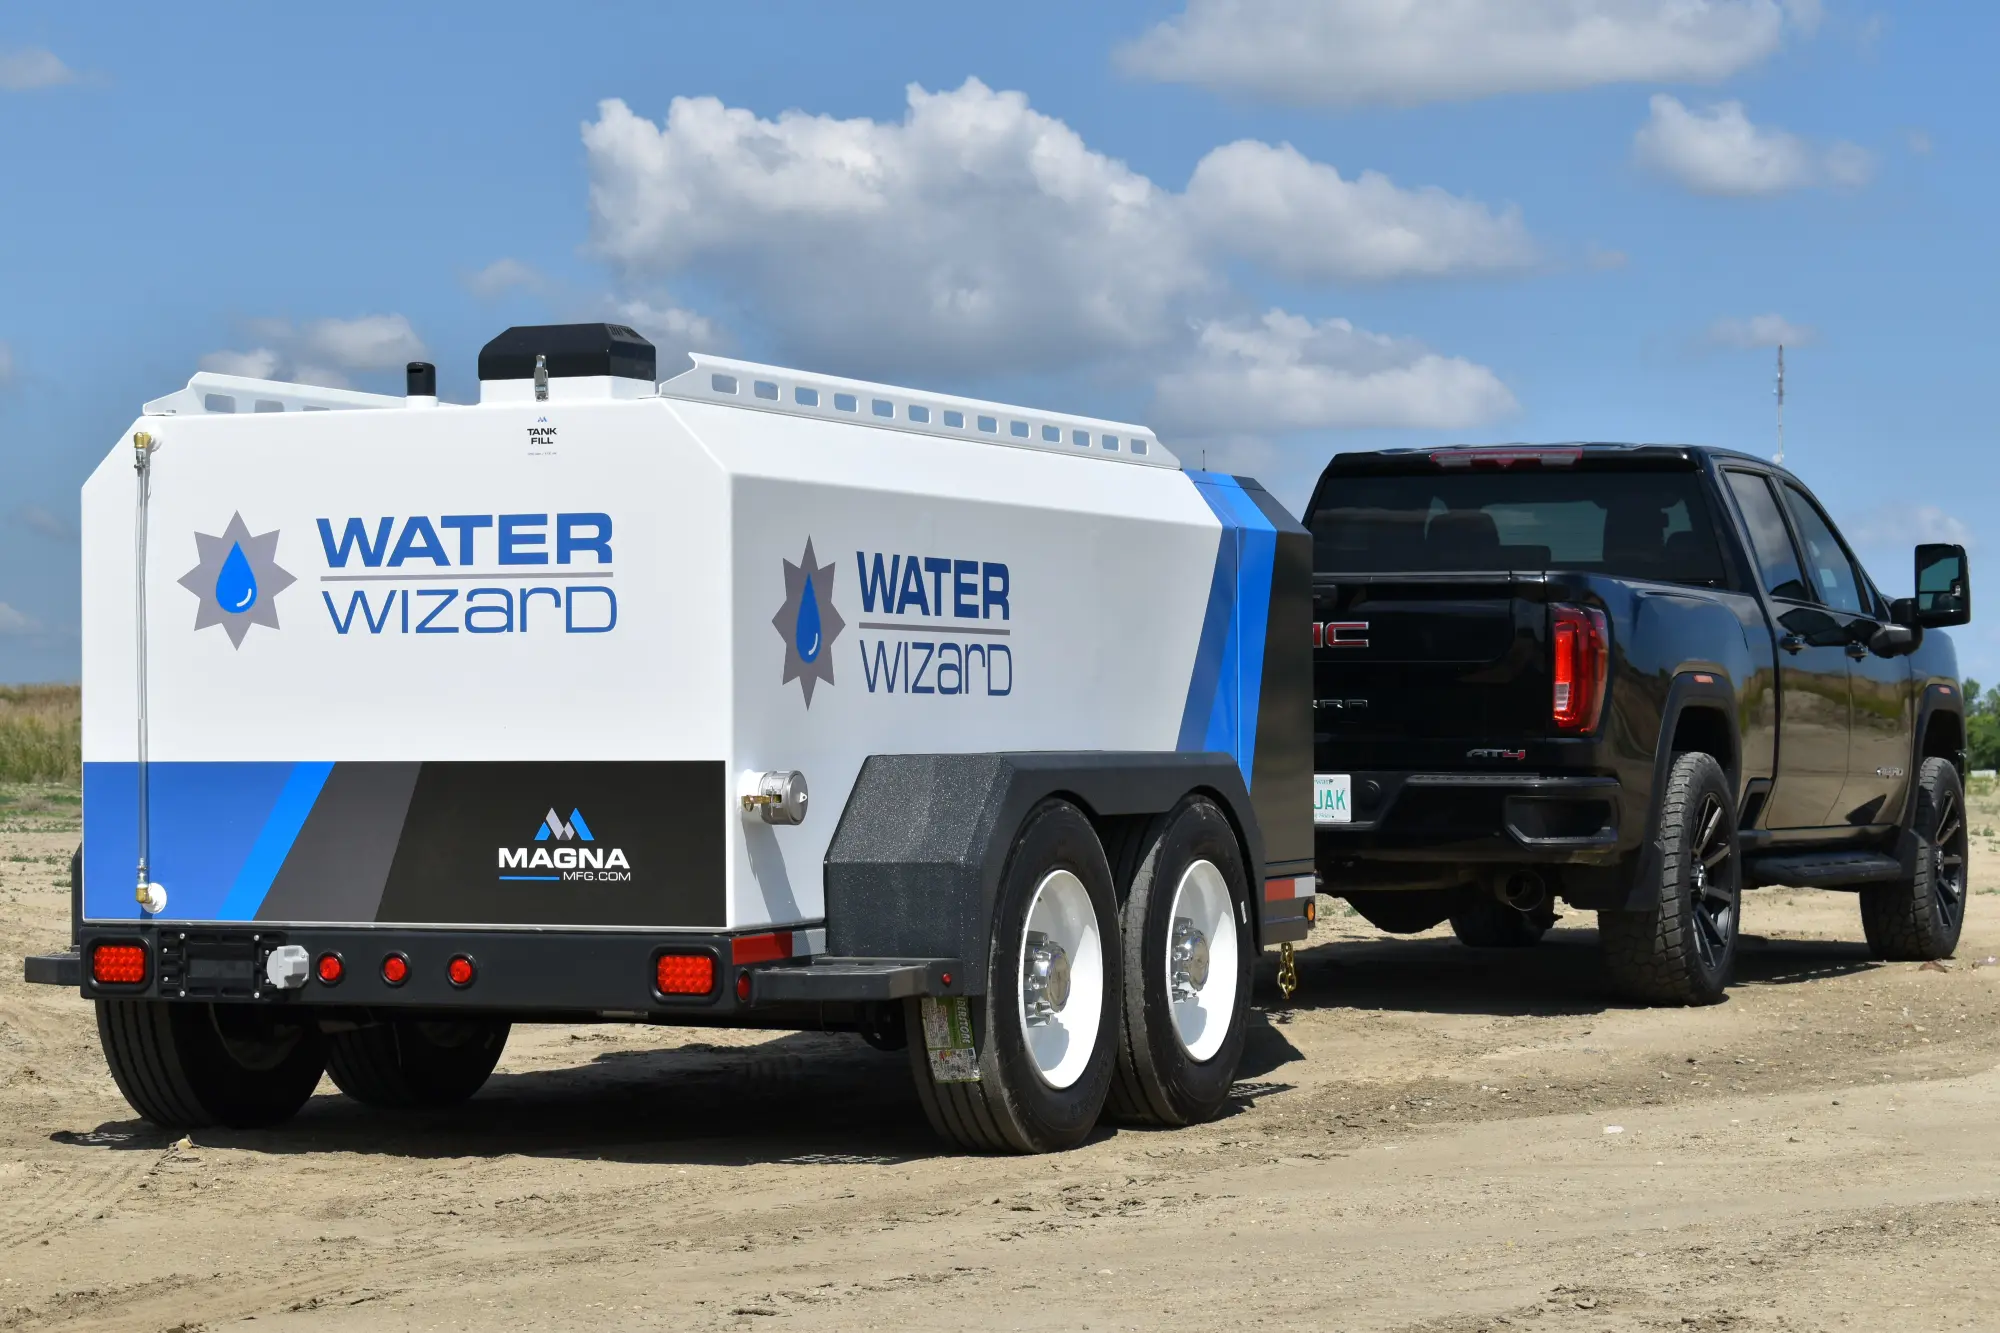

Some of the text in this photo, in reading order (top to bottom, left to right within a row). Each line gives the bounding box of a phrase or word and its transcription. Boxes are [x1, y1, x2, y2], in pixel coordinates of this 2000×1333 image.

[316, 512, 613, 568] WATER
[856, 551, 1010, 620] WATER
[498, 847, 631, 869] MAGNA
[563, 871, 631, 882] MFG.COM
